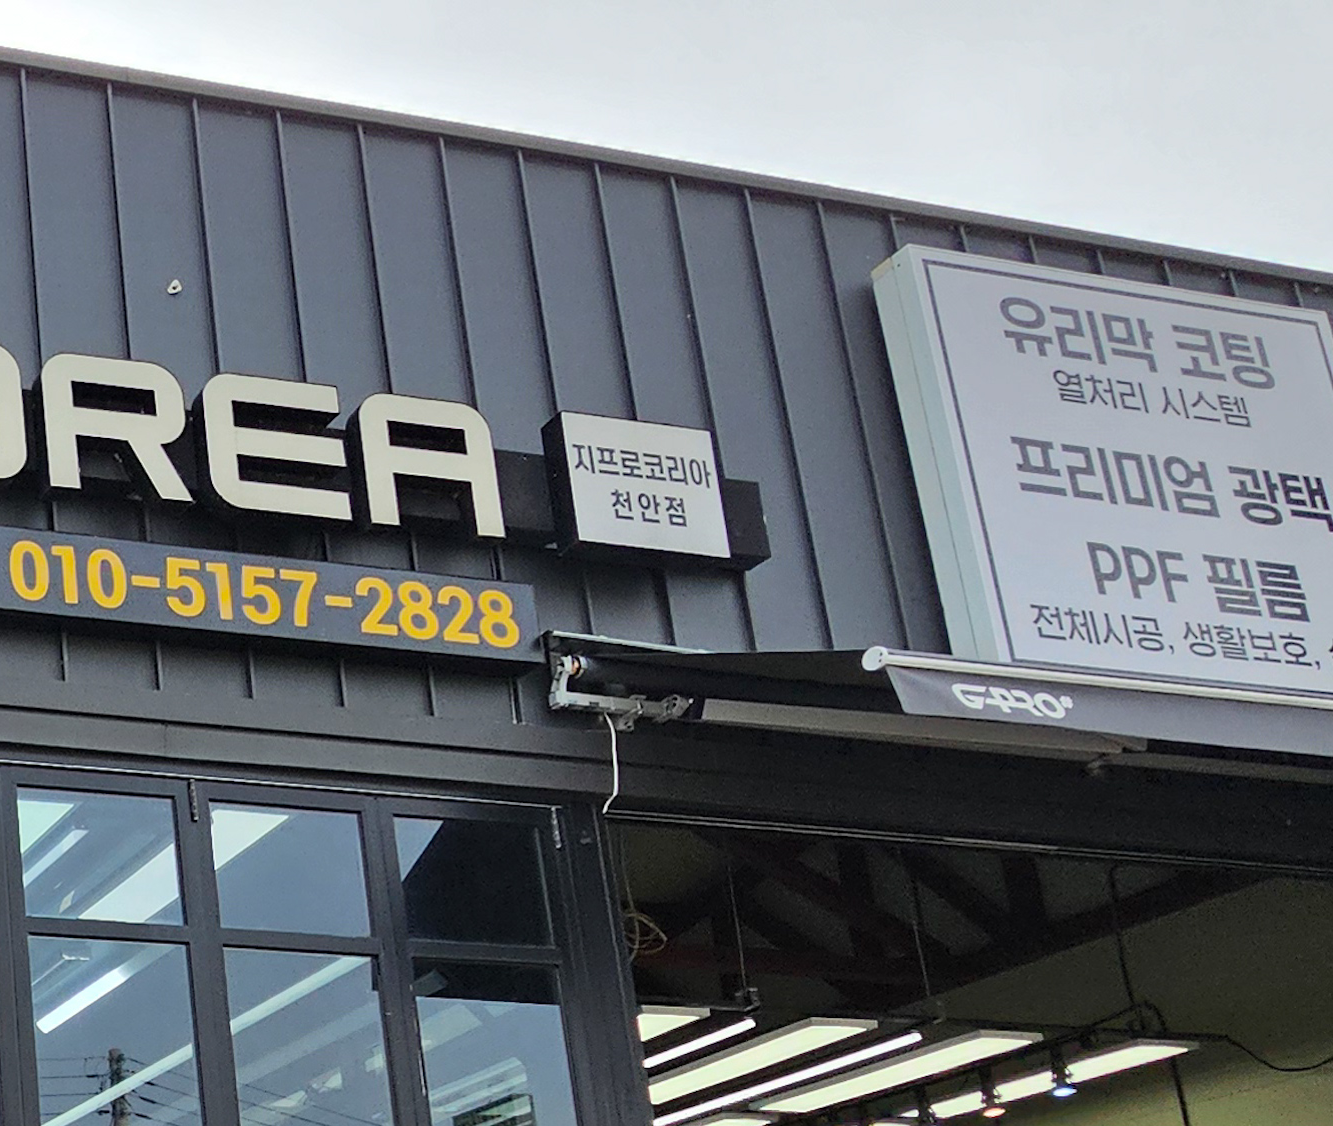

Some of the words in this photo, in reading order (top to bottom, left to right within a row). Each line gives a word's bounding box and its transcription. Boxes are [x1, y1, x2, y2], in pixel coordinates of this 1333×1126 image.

[999, 296, 1158, 373] 유리막
[1171, 323, 1275, 390] 코팅
[1052, 368, 1149, 415] 열처리
[1161, 385, 1252, 429] 시스템
[572, 443, 712, 489] 지프로코리아
[1009, 435, 1221, 519] 프리미엄
[1227, 465, 1333, 533] 광택
[610, 488, 688, 528] 천안점
[8, 538, 520, 649] 010-5157-2828
[1086, 540, 1189, 603] PPF
[1201, 553, 1311, 623] 필름
[1029, 603, 1175, 655] 전체시공,
[1183, 620, 1321, 671] 생활보호,
